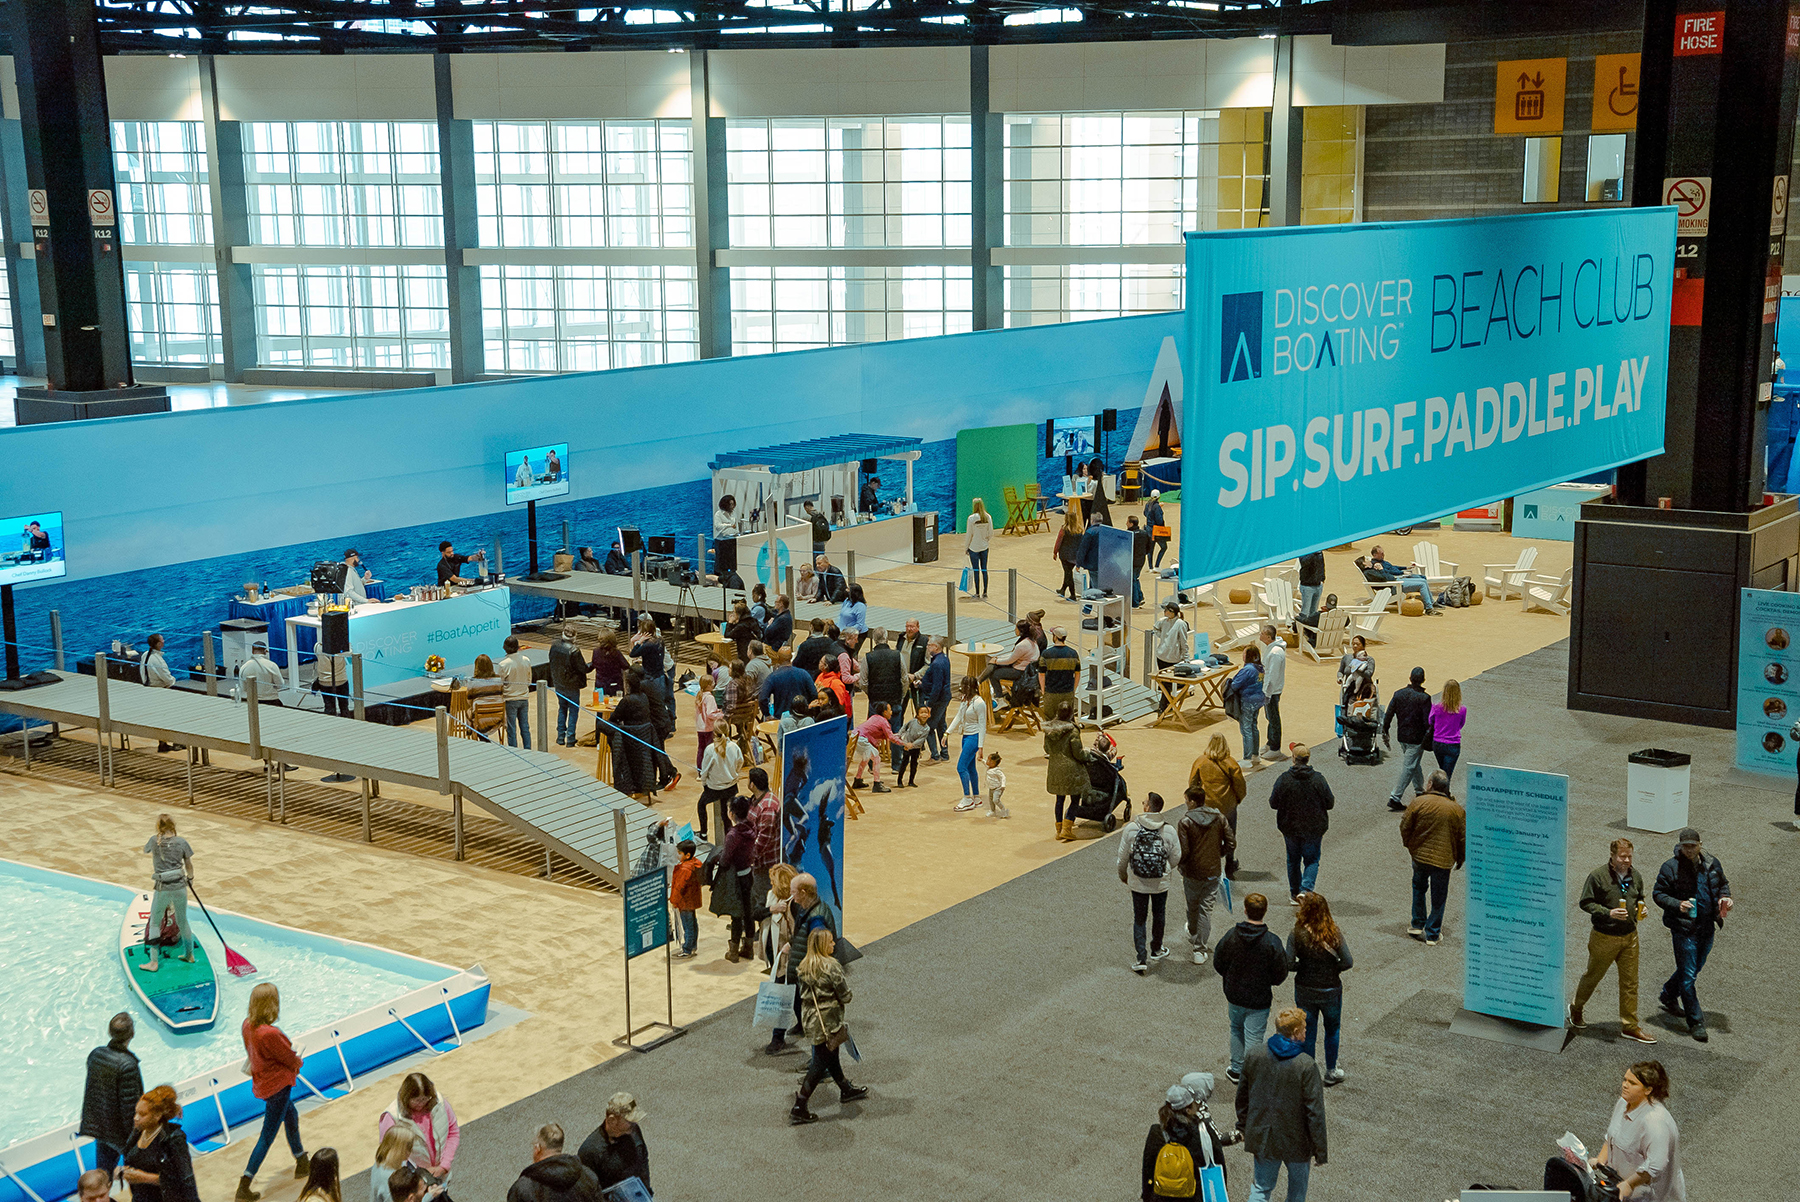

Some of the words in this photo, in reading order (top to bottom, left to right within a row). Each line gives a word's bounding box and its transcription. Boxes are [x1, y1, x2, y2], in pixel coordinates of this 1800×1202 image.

[1684, 18, 1716, 33] FIRE
[1680, 34, 1718, 50] HOSE
[1678, 219, 1708, 228] MOKING
[36, 229, 48, 238] K12
[94, 230, 112, 238] K12
[1676, 244, 1698, 258] 12
[1770, 242, 1780, 255] P12
[1275, 278, 1412, 328] DISCOVER
[1431, 262, 1564, 354] BEACH
[1574, 254, 1654, 329] CLUB
[428, 618, 500, 644] #BoatAppetit
[356, 630, 418, 652] DISCOVER
[1471, 784, 1524, 797] #BOATAPPETIT
[1526, 791, 1564, 802] SCHEDULE
[1485, 825, 1514, 835] Saturday,
[1516, 830, 1540, 838] January
[1485, 913, 1510, 922] Sunday,
[1512, 917, 1537, 927] January
